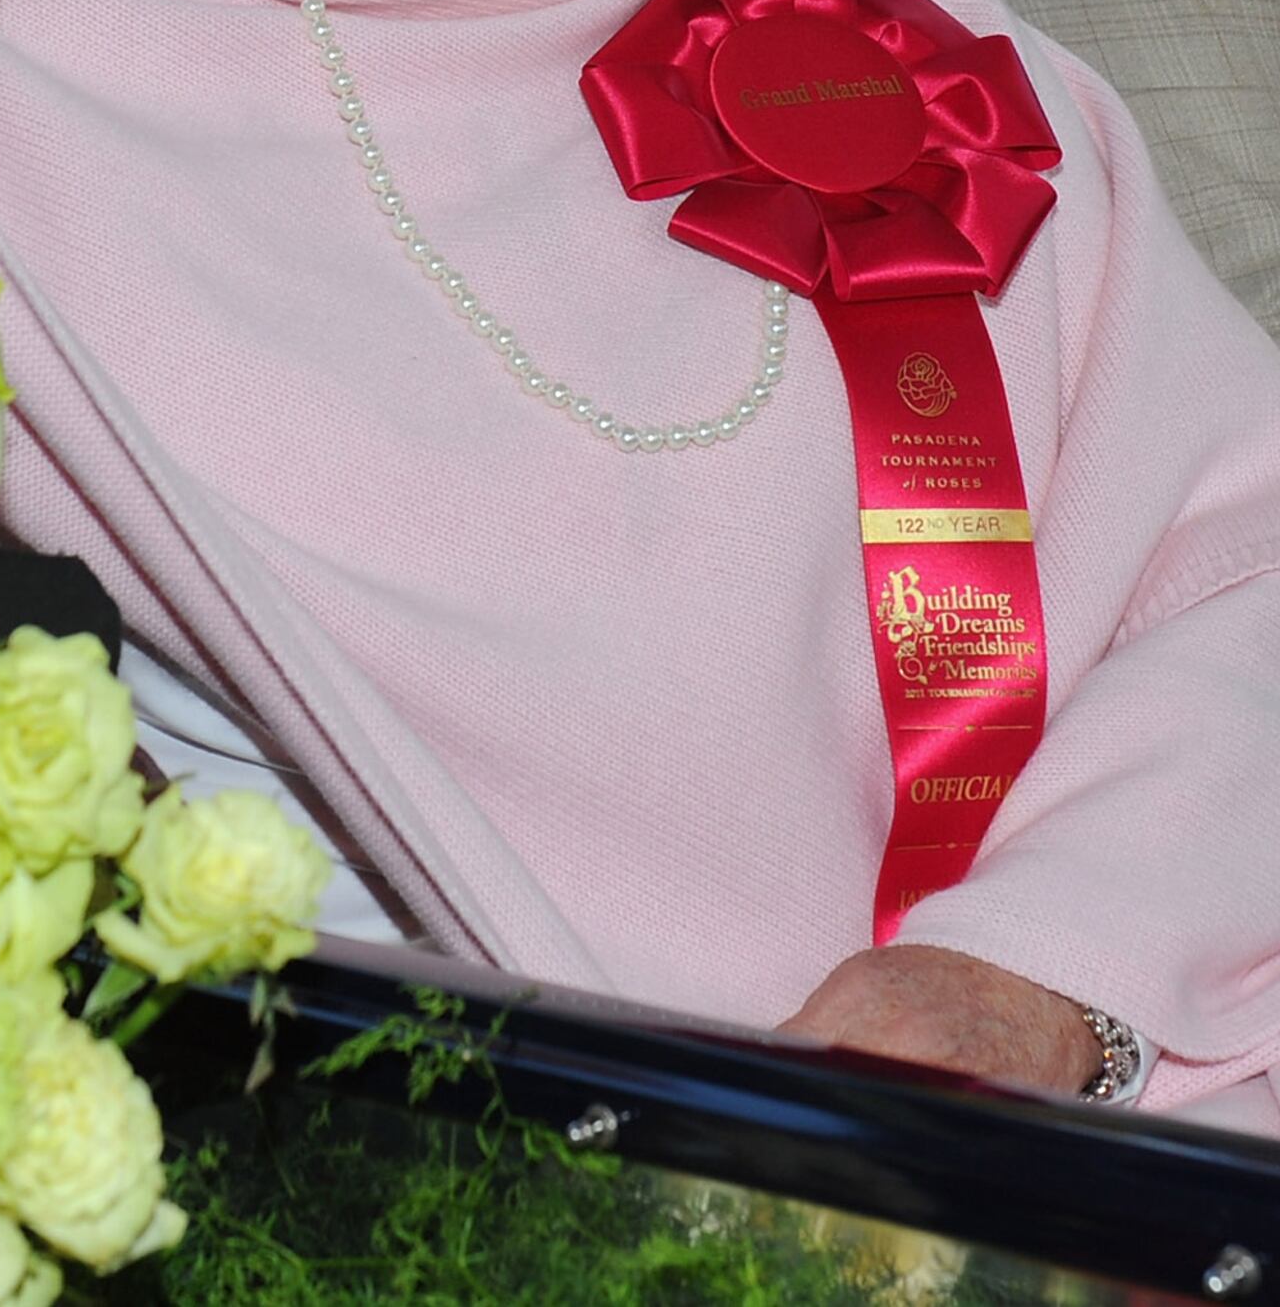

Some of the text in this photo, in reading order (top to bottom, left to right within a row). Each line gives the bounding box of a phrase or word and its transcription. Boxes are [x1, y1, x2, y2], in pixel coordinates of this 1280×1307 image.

[740, 74, 905, 109] Grand Marshal
[891, 433, 981, 447] PASADENA
[881, 455, 997, 467] TOURNAMENT
[925, 477, 982, 489] ROSES
[948, 516, 1001, 533] YEAR
[887, 565, 1013, 619] Building
[935, 612, 1025, 634] Dreams
[919, 634, 1036, 661] Friendships
[940, 659, 1037, 680] Memories
